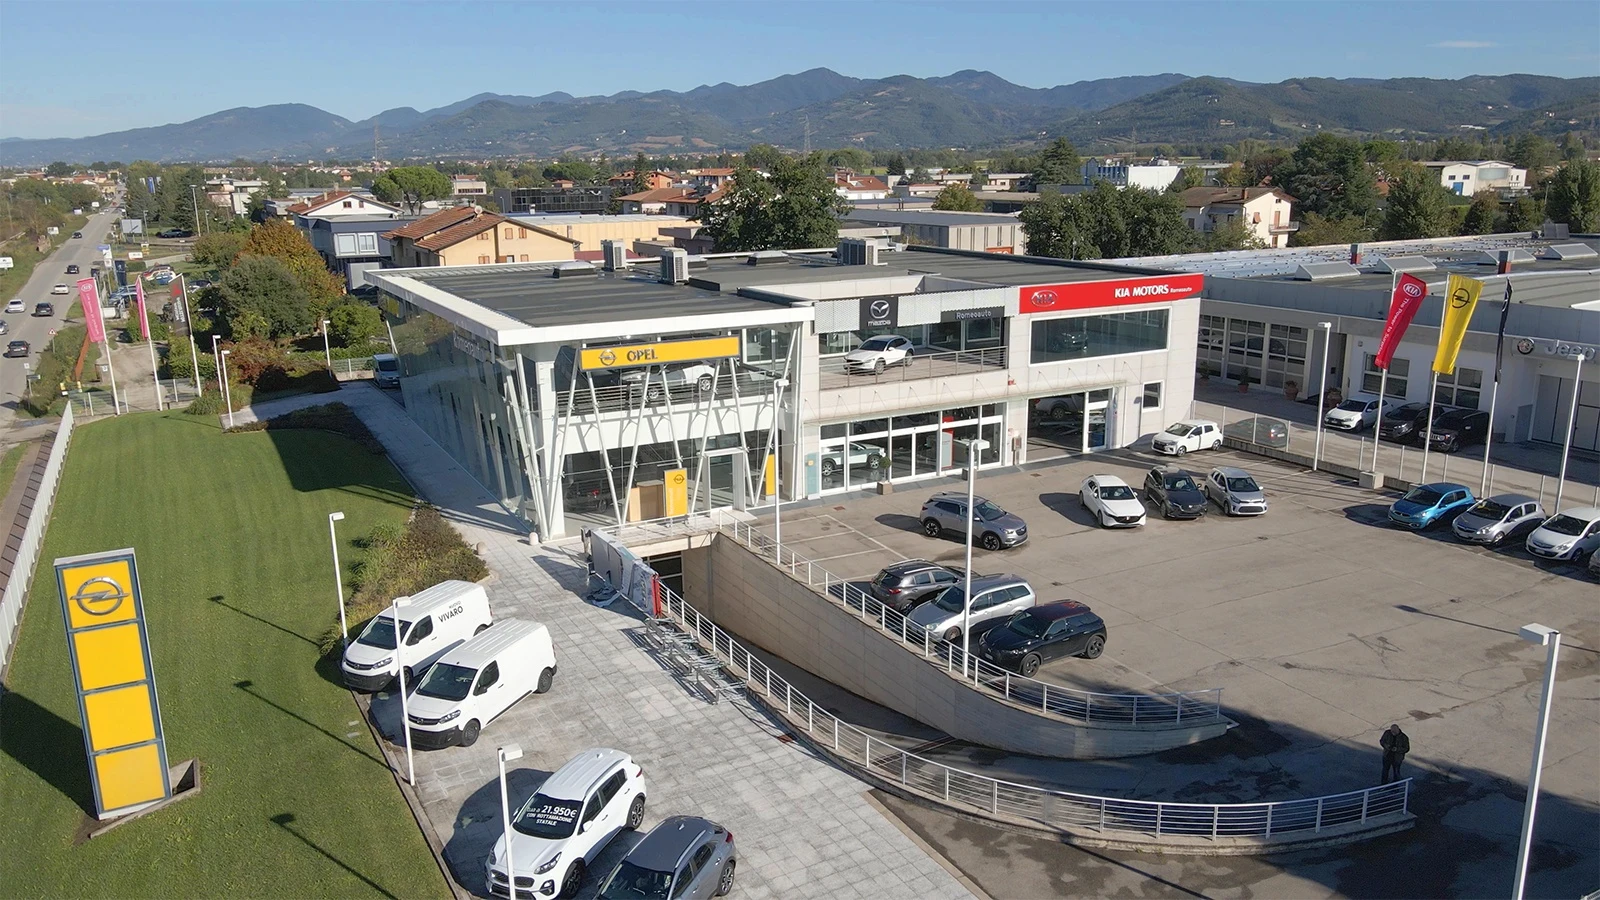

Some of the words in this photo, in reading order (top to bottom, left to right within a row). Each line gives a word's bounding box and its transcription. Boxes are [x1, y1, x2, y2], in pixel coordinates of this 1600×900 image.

[1114, 287, 1130, 298] KIA
[1132, 284, 1169, 297] MOTORS
[956, 310, 991, 320] Romeoauto
[626, 349, 658, 362] OPEL
[1544, 340, 1596, 361] Jeep
[438, 605, 463, 622] VIVARO
[537, 813, 573, 823] ROTTAMAZIONE
[541, 805, 577, 818] 21.950€
